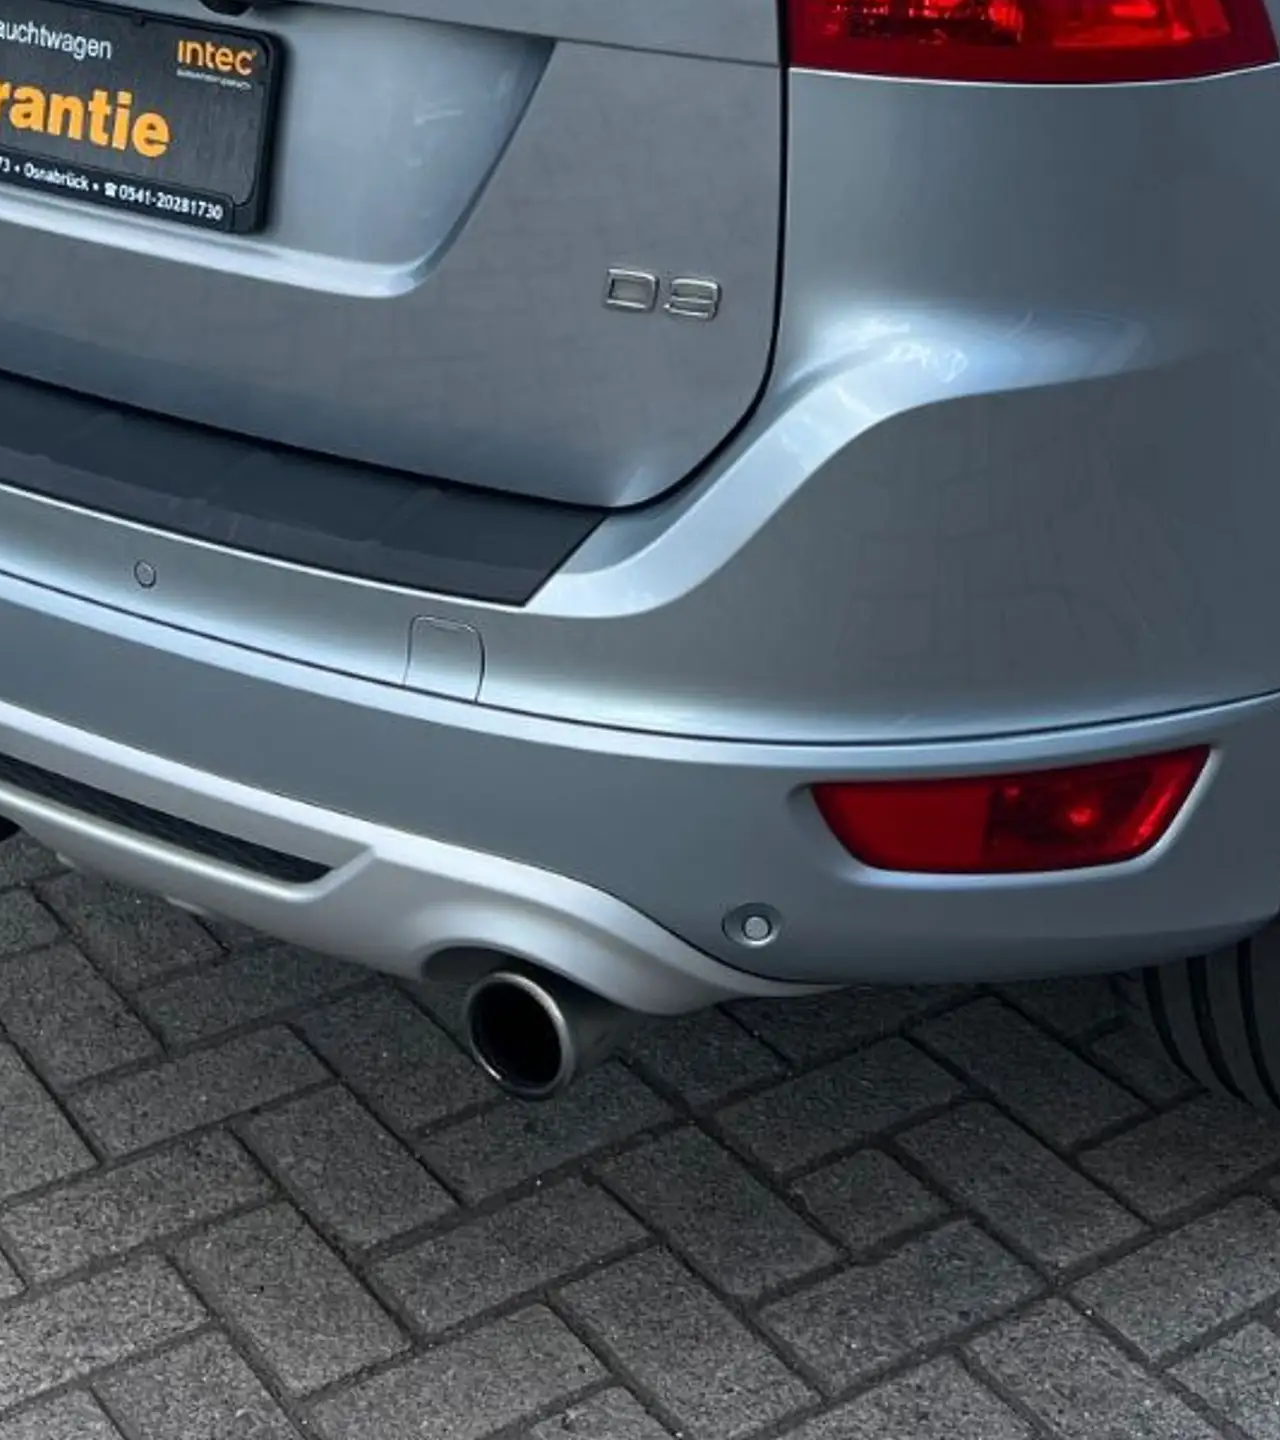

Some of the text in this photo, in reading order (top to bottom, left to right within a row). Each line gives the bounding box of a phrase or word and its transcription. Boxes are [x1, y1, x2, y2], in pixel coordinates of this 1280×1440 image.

[176, 39, 253, 76] intec
[24, 162, 90, 192] Osnabrück
[119, 184, 223, 221] 0541-20281730
[606, 268, 722, 321] D3
